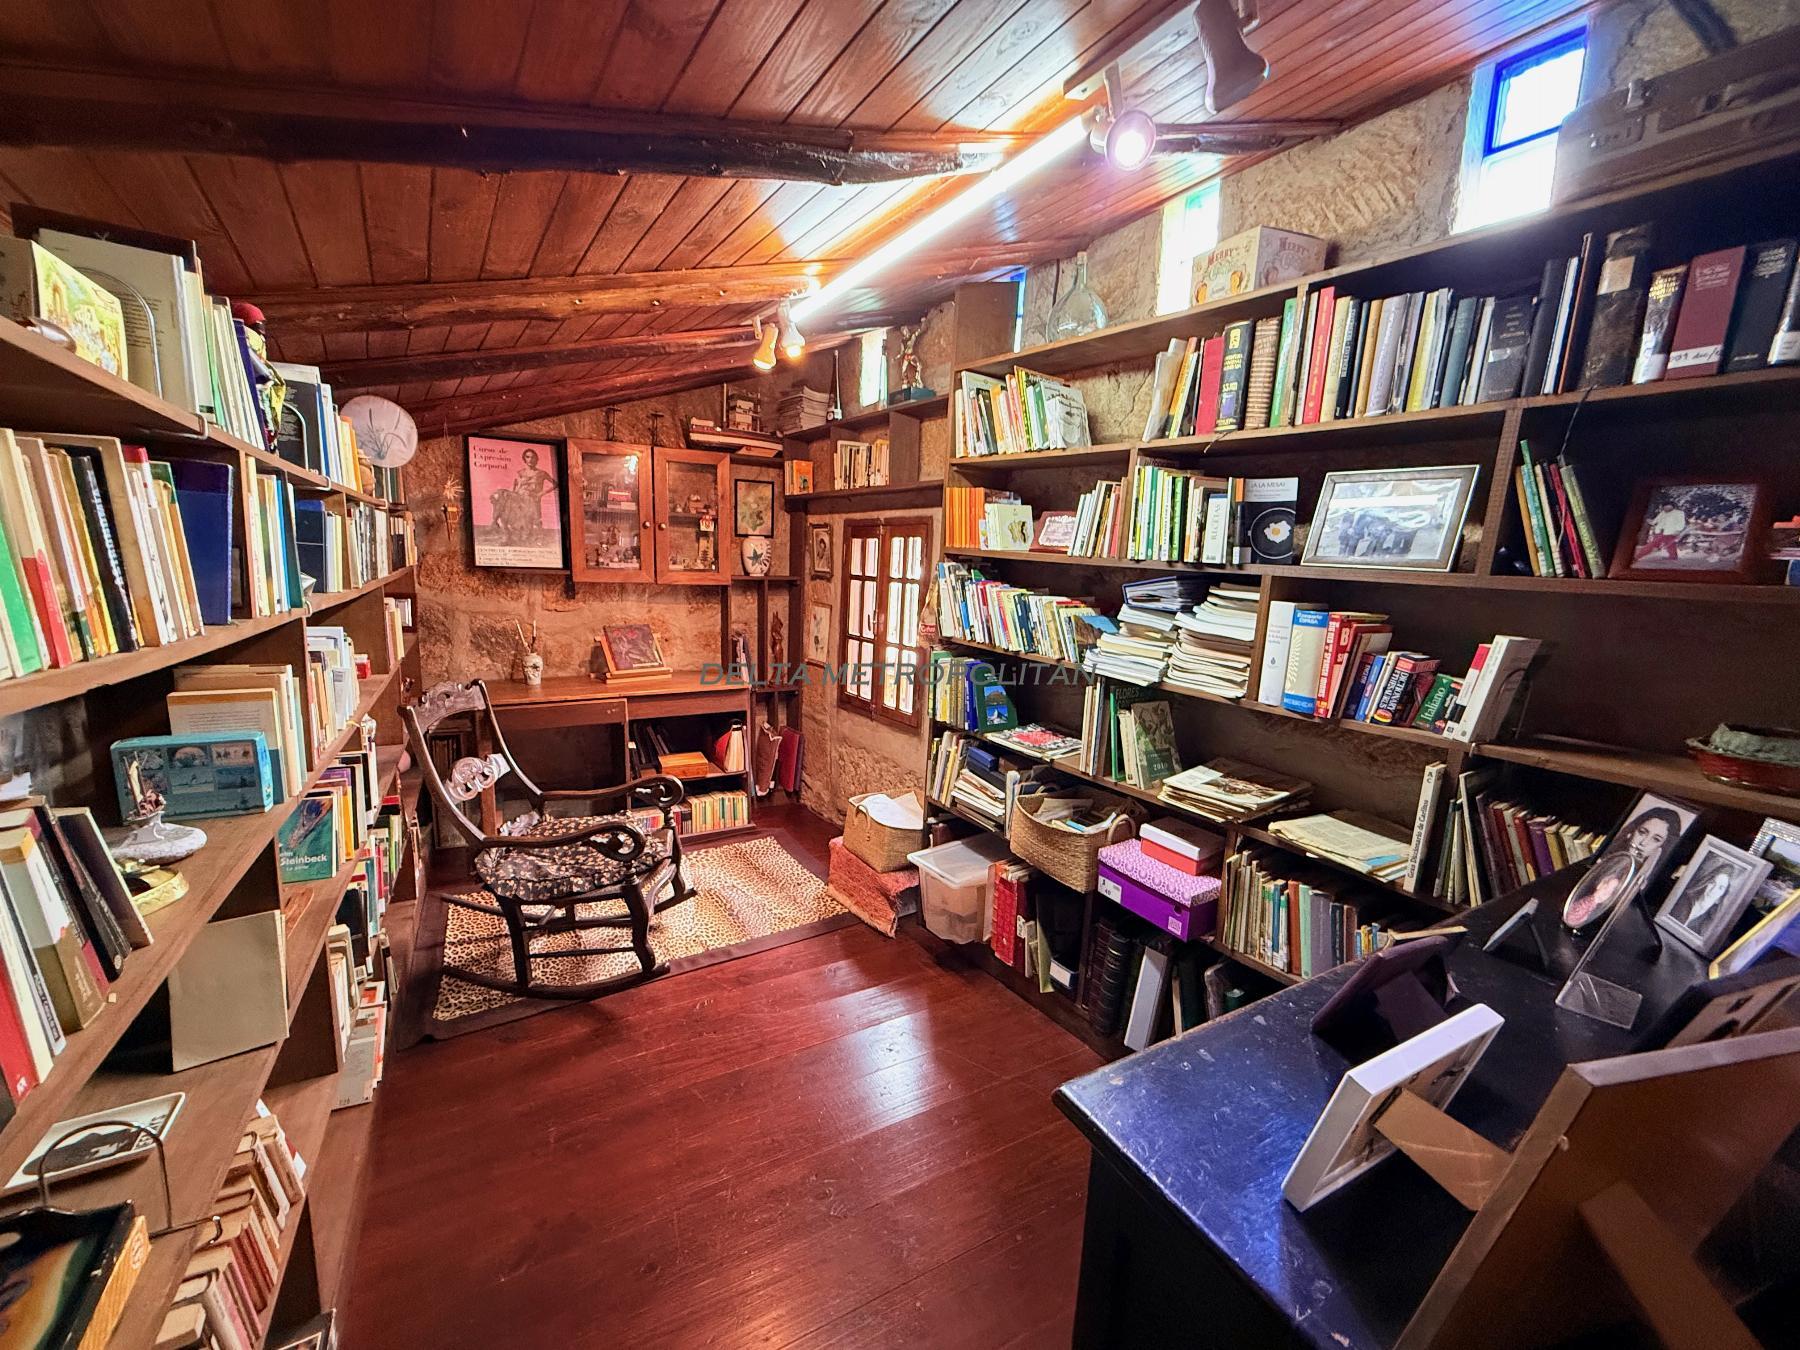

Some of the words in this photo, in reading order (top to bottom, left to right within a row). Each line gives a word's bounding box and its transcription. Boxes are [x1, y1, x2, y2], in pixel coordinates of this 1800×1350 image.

[1207, 248, 1233, 266] MERRY
[473, 445, 496, 453] Curso
[474, 461, 508, 470] Corporal
[1387, 671, 1409, 712] DICTIONARY
[1420, 687, 1446, 720] Italiano
[1410, 831, 1422, 862] Diccionario
[280, 854, 327, 865] Steinbeck
